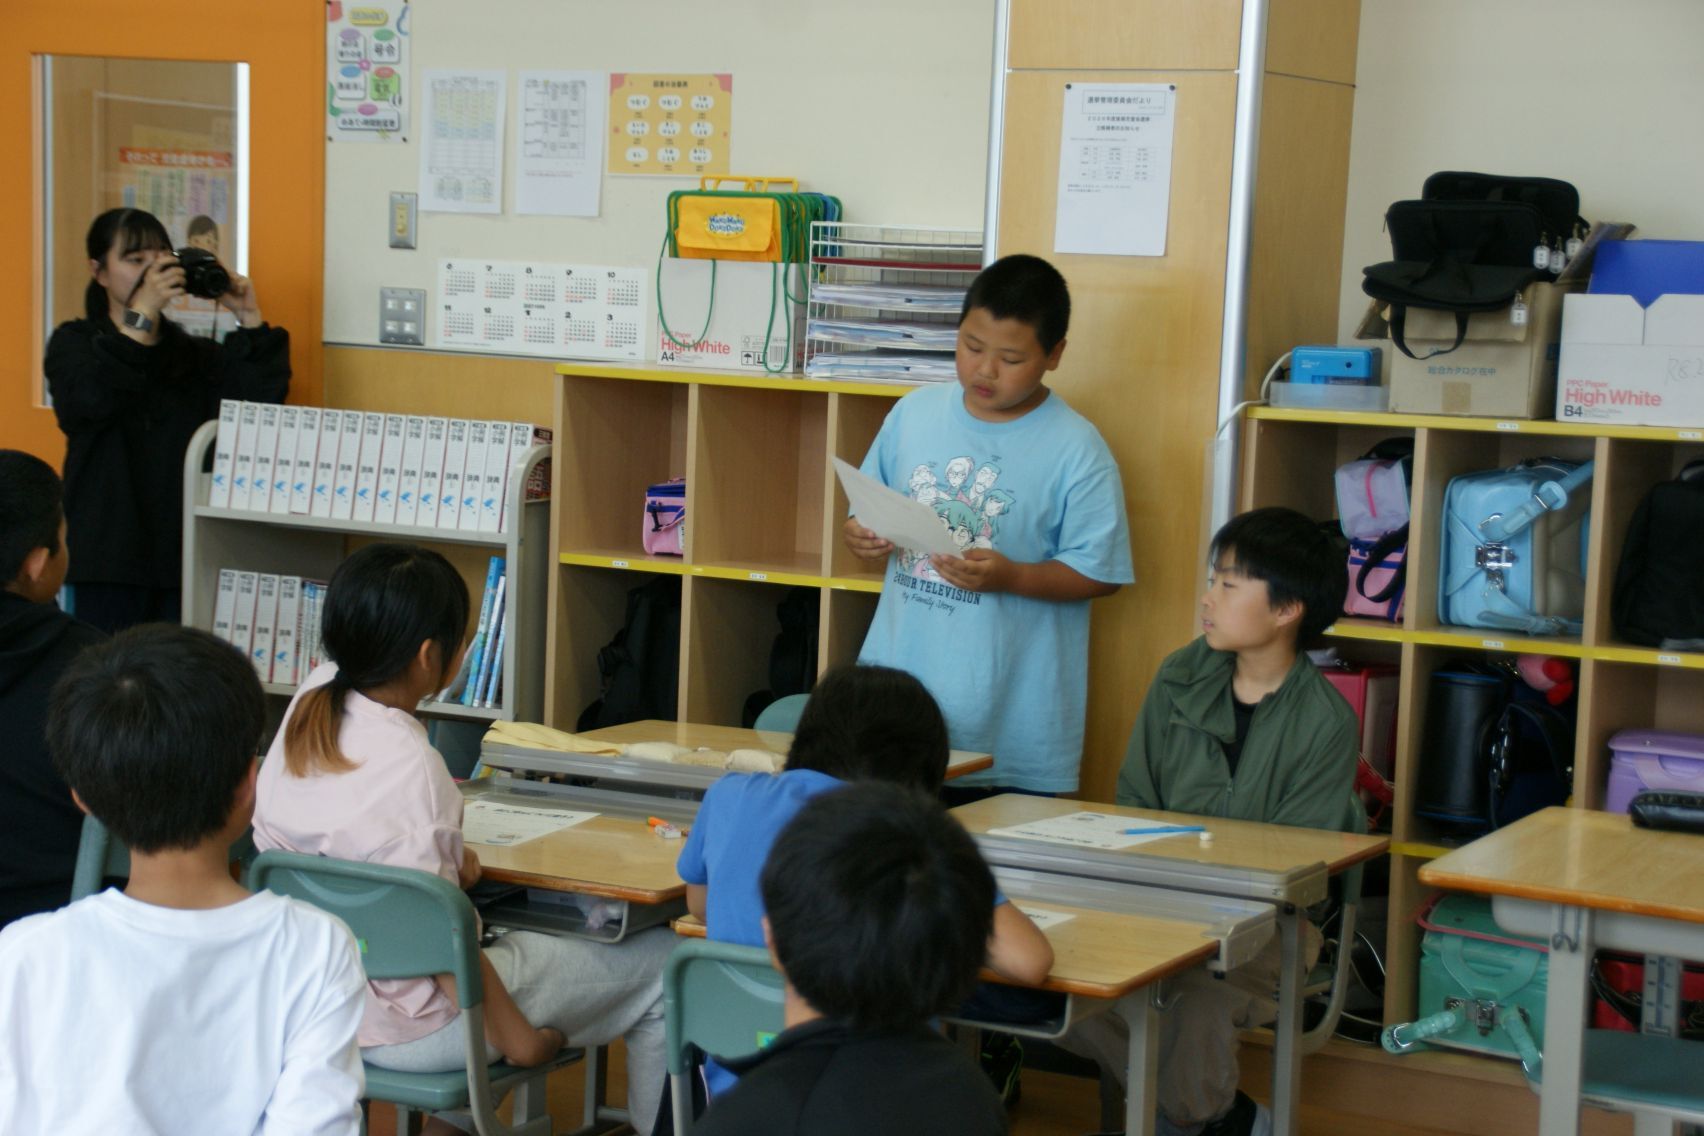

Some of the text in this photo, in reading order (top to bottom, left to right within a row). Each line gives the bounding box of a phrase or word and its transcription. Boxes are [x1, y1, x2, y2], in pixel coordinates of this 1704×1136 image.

[692, 338, 730, 355] White
[661, 351, 675, 362] A4
[1565, 387, 1663, 407] High White
[1564, 404, 1584, 417] B4
[919, 579, 982, 605] TELEVISION
